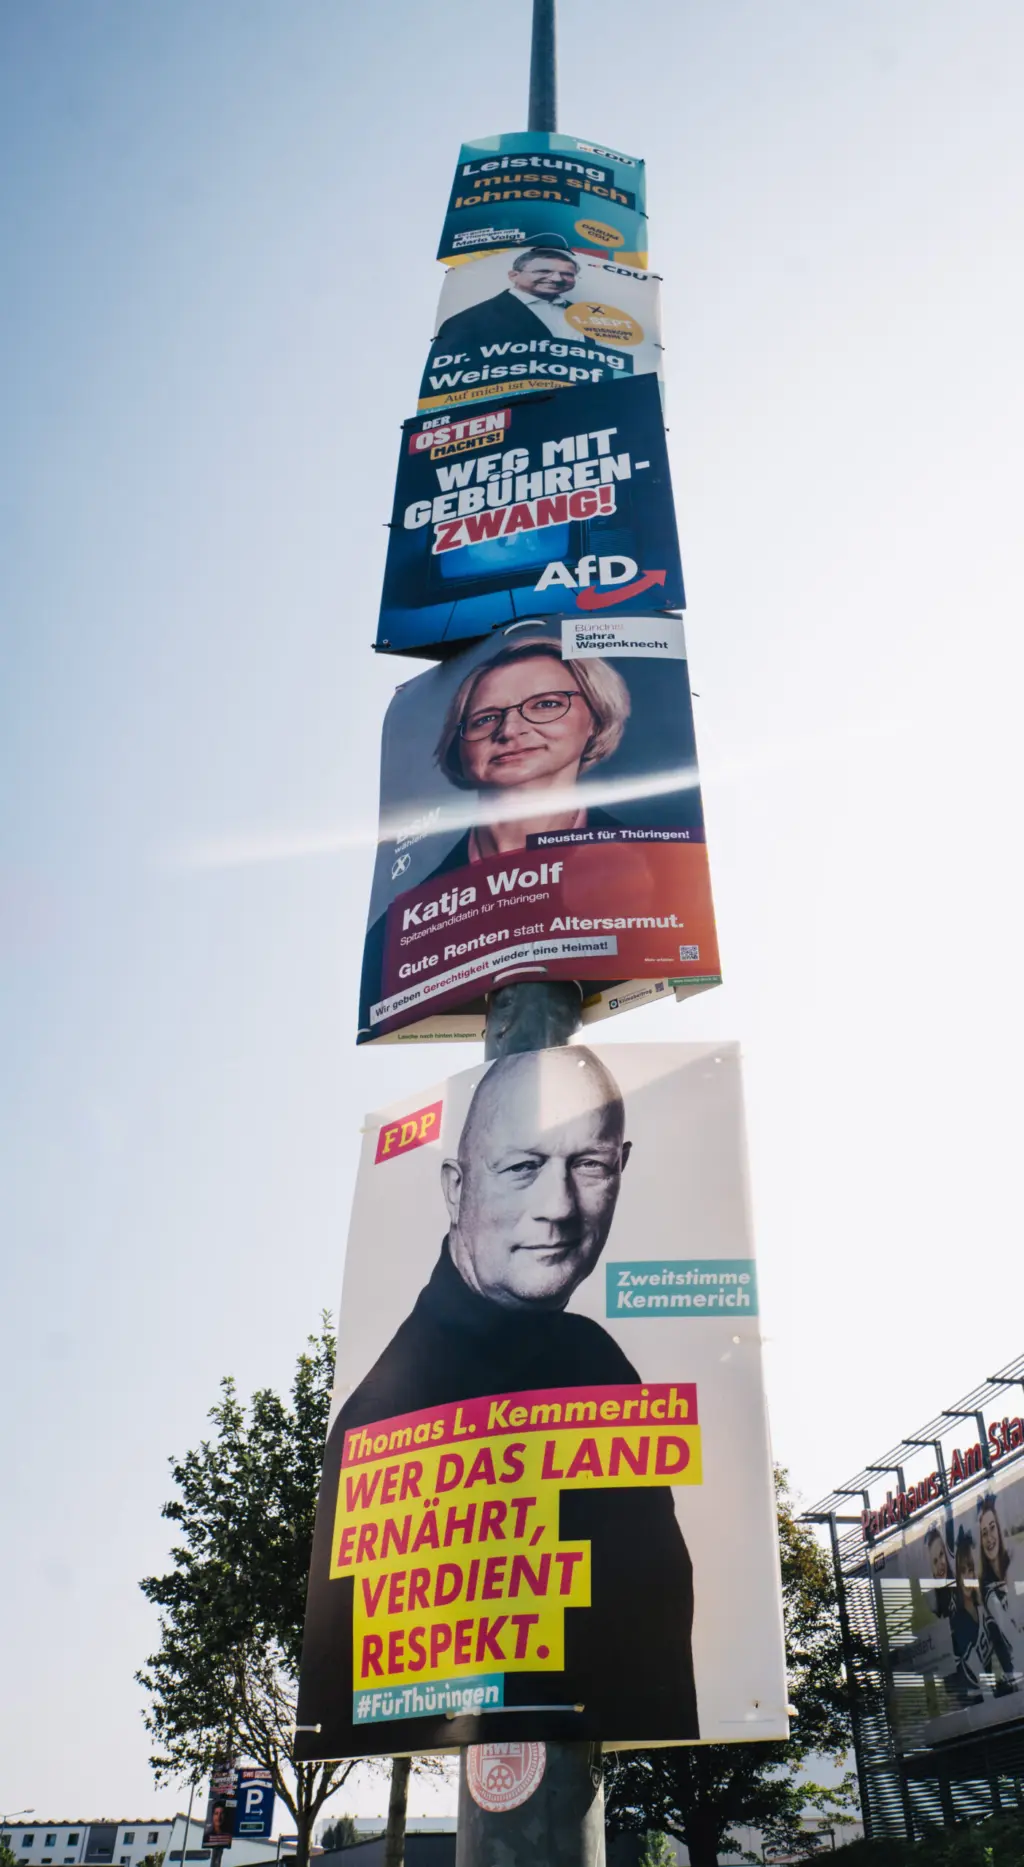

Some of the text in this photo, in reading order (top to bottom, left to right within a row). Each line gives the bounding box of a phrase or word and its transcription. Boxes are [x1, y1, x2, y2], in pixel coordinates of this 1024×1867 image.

[462, 155, 606, 183] Leistung
[593, 148, 633, 165] CDU
[454, 189, 572, 209] lohnen.
[473, 173, 628, 204] muss sich
[455, 233, 521, 247] Mario Voigt
[602, 264, 649, 281] CDU
[432, 340, 626, 370] Dr. Wolfgang
[428, 360, 604, 391] Weisskopf
[444, 390, 470, 404] Auf
[471, 386, 504, 399] mich
[508, 382, 524, 391] ist
[415, 411, 506, 450] OSTEN
[422, 415, 451, 431] DER
[434, 432, 501, 458] MACHTS!
[435, 427, 618, 492] WEG MIT
[403, 453, 650, 530] GEBÜHREN-
[435, 485, 614, 553] ZWANG!
[533, 555, 639, 592] AfD
[575, 632, 616, 642] Sahra
[575, 640, 669, 650] Wagenknecht
[537, 830, 690, 845] Neustart für Thüringen!
[401, 861, 564, 932] Katja Wolf
[400, 892, 550, 946] Spitzenkandidatin für Thüringen
[398, 914, 685, 979] Gute Renten statt Altersarmut.
[375, 941, 609, 1017] Wir geben Gerechtigkeit wieder eine Heimat!
[382, 1111, 436, 1155] FDP
[617, 1268, 751, 1287] Zweitstimme
[617, 1287, 750, 1309] Kemmerich
[347, 1388, 689, 1461] Thomas L. Kemmerich
[345, 1435, 691, 1513] WER DAS LAND
[861, 1471, 940, 1542] Parkhaus
[950, 1443, 983, 1488] Am
[336, 1495, 546, 1568] ERNÄHRT,
[361, 1551, 584, 1618] VERDIENT
[360, 1613, 550, 1678] RESPEKT.
[356, 1682, 499, 1719] #FürThüringen
[245, 1789, 264, 1814] P
